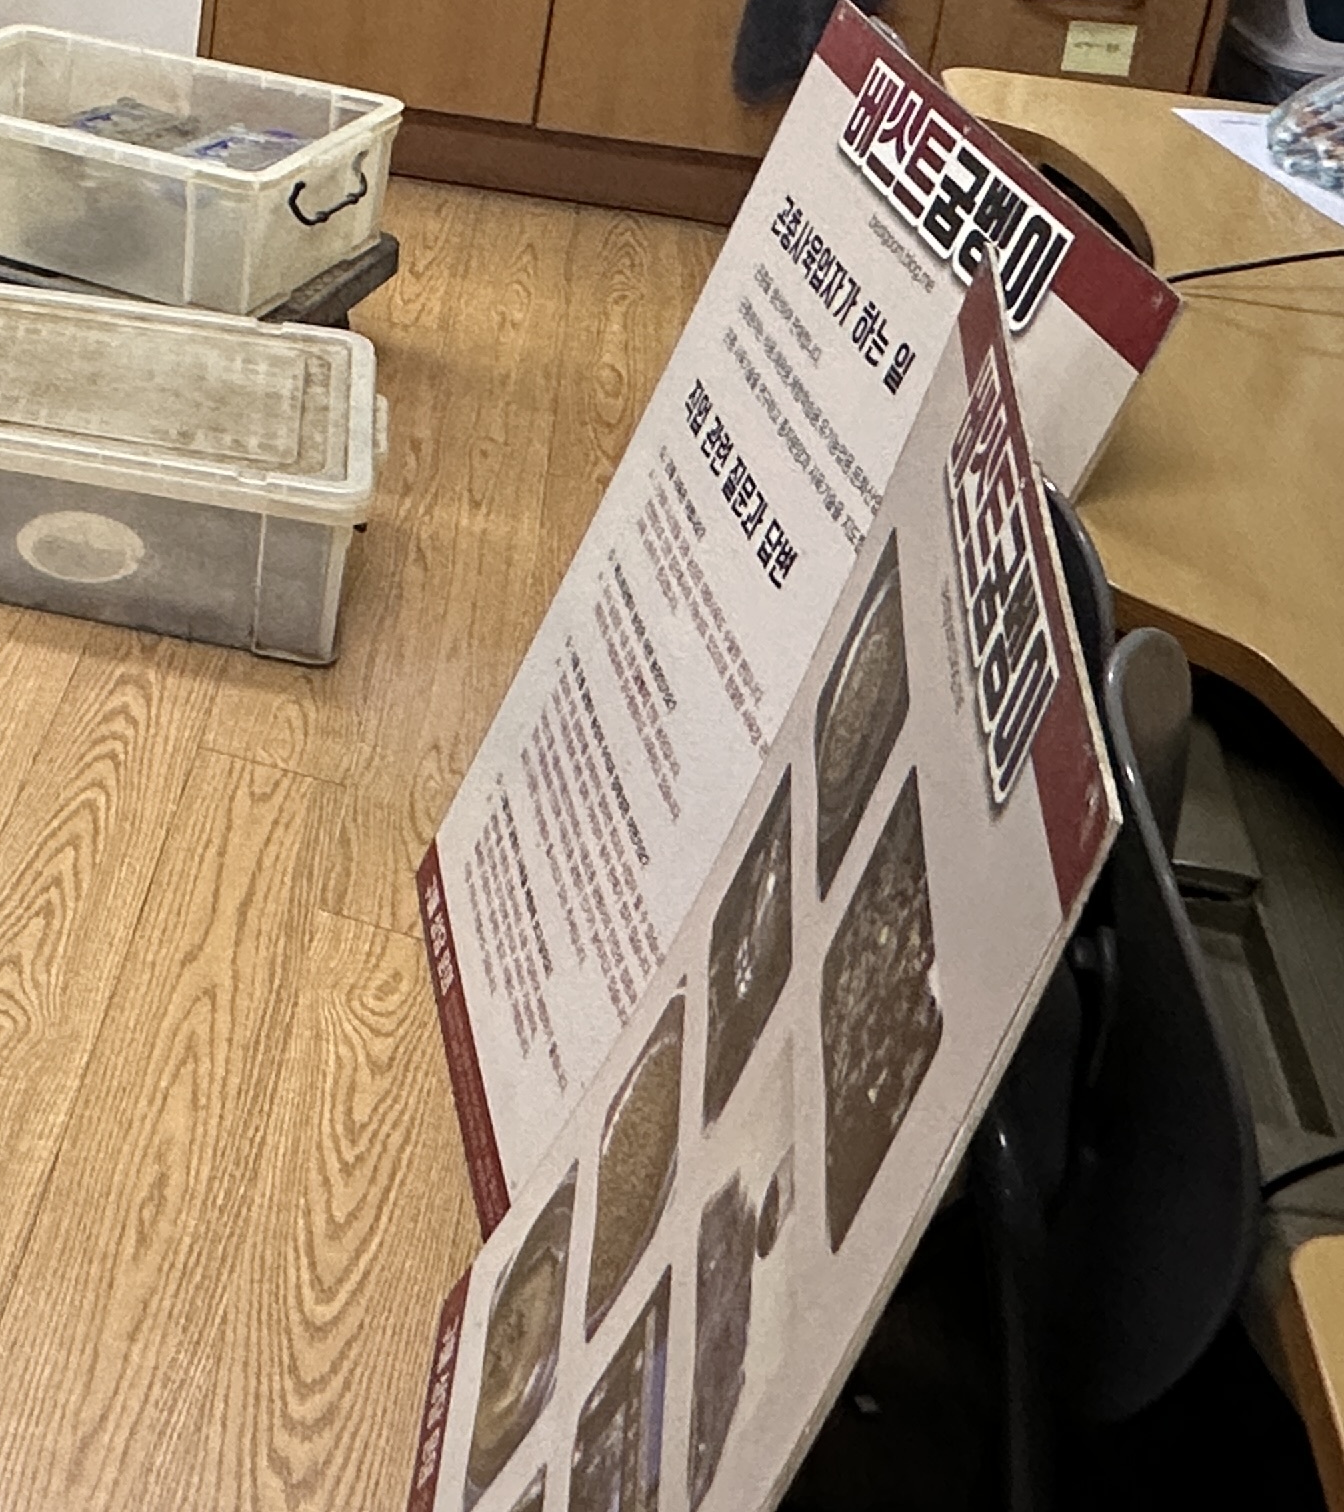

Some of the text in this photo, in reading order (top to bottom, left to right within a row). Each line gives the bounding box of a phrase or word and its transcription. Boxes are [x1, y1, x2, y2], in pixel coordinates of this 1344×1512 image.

[771, 196, 915, 394] 곤충사육업자가 하는 일
[839, 58, 1074, 332] 베스트굼벵이
[684, 378, 797, 588] 직업 관련 질문과 답변
